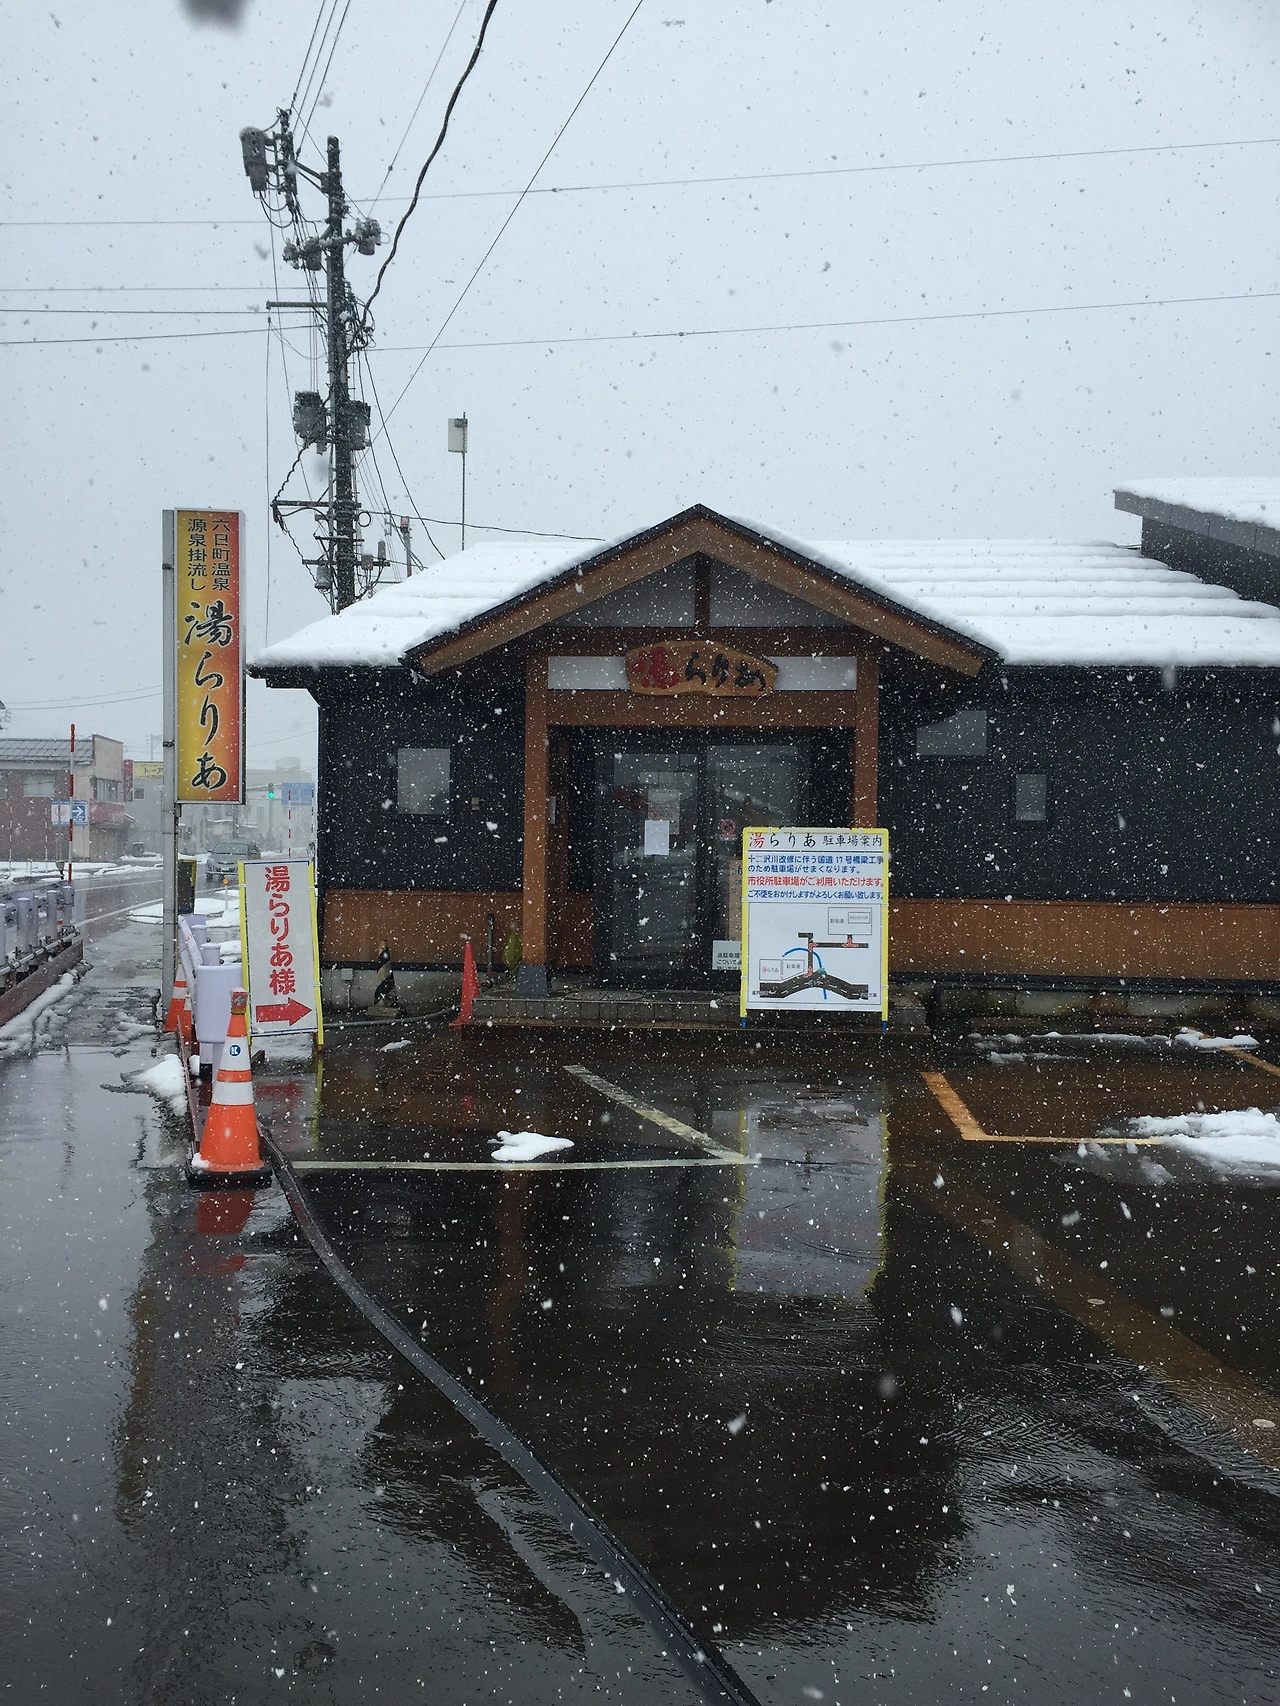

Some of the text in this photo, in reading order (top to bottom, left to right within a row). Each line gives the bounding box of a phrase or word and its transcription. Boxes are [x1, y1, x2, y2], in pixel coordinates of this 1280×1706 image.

[187, 518, 208, 591] 源泉掛流し
[212, 518, 231, 591] 六日町温泉
[184, 600, 233, 791] 湯らりあ
[631, 646, 767, 691] 湯らりあ
[748, 864, 860, 874] のため駐車場がせまくなります。
[749, 832, 816, 849] 湯らりあ
[822, 834, 882, 847] 駐車場案内
[748, 876, 884, 888] 市役所駐車場がご利用いただけます。
[264, 865, 296, 996] 湯らりあ様
